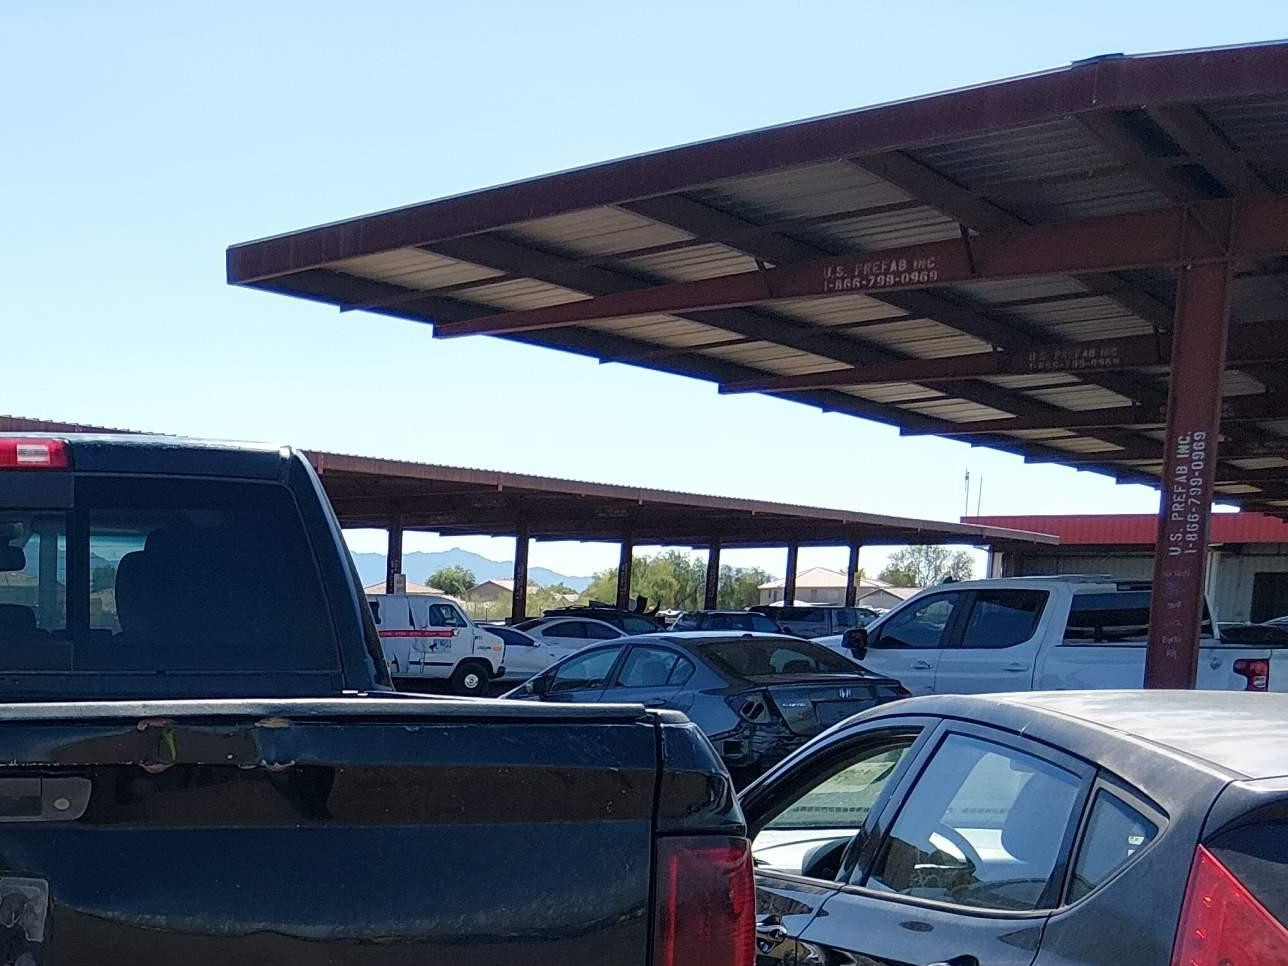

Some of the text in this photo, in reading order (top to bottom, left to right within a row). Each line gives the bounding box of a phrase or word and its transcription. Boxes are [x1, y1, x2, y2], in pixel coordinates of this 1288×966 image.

[822, 270, 938, 292] 1-866-799-0969
[823, 265, 848, 279] U.S.
[854, 259, 907, 276] PREFAB
[1176, 431, 1192, 458] INC.
[1171, 465, 1188, 521] PREFAB
[1184, 431, 1206, 554] 1-866-799-0969
[1168, 528, 1184, 556] U.S.
